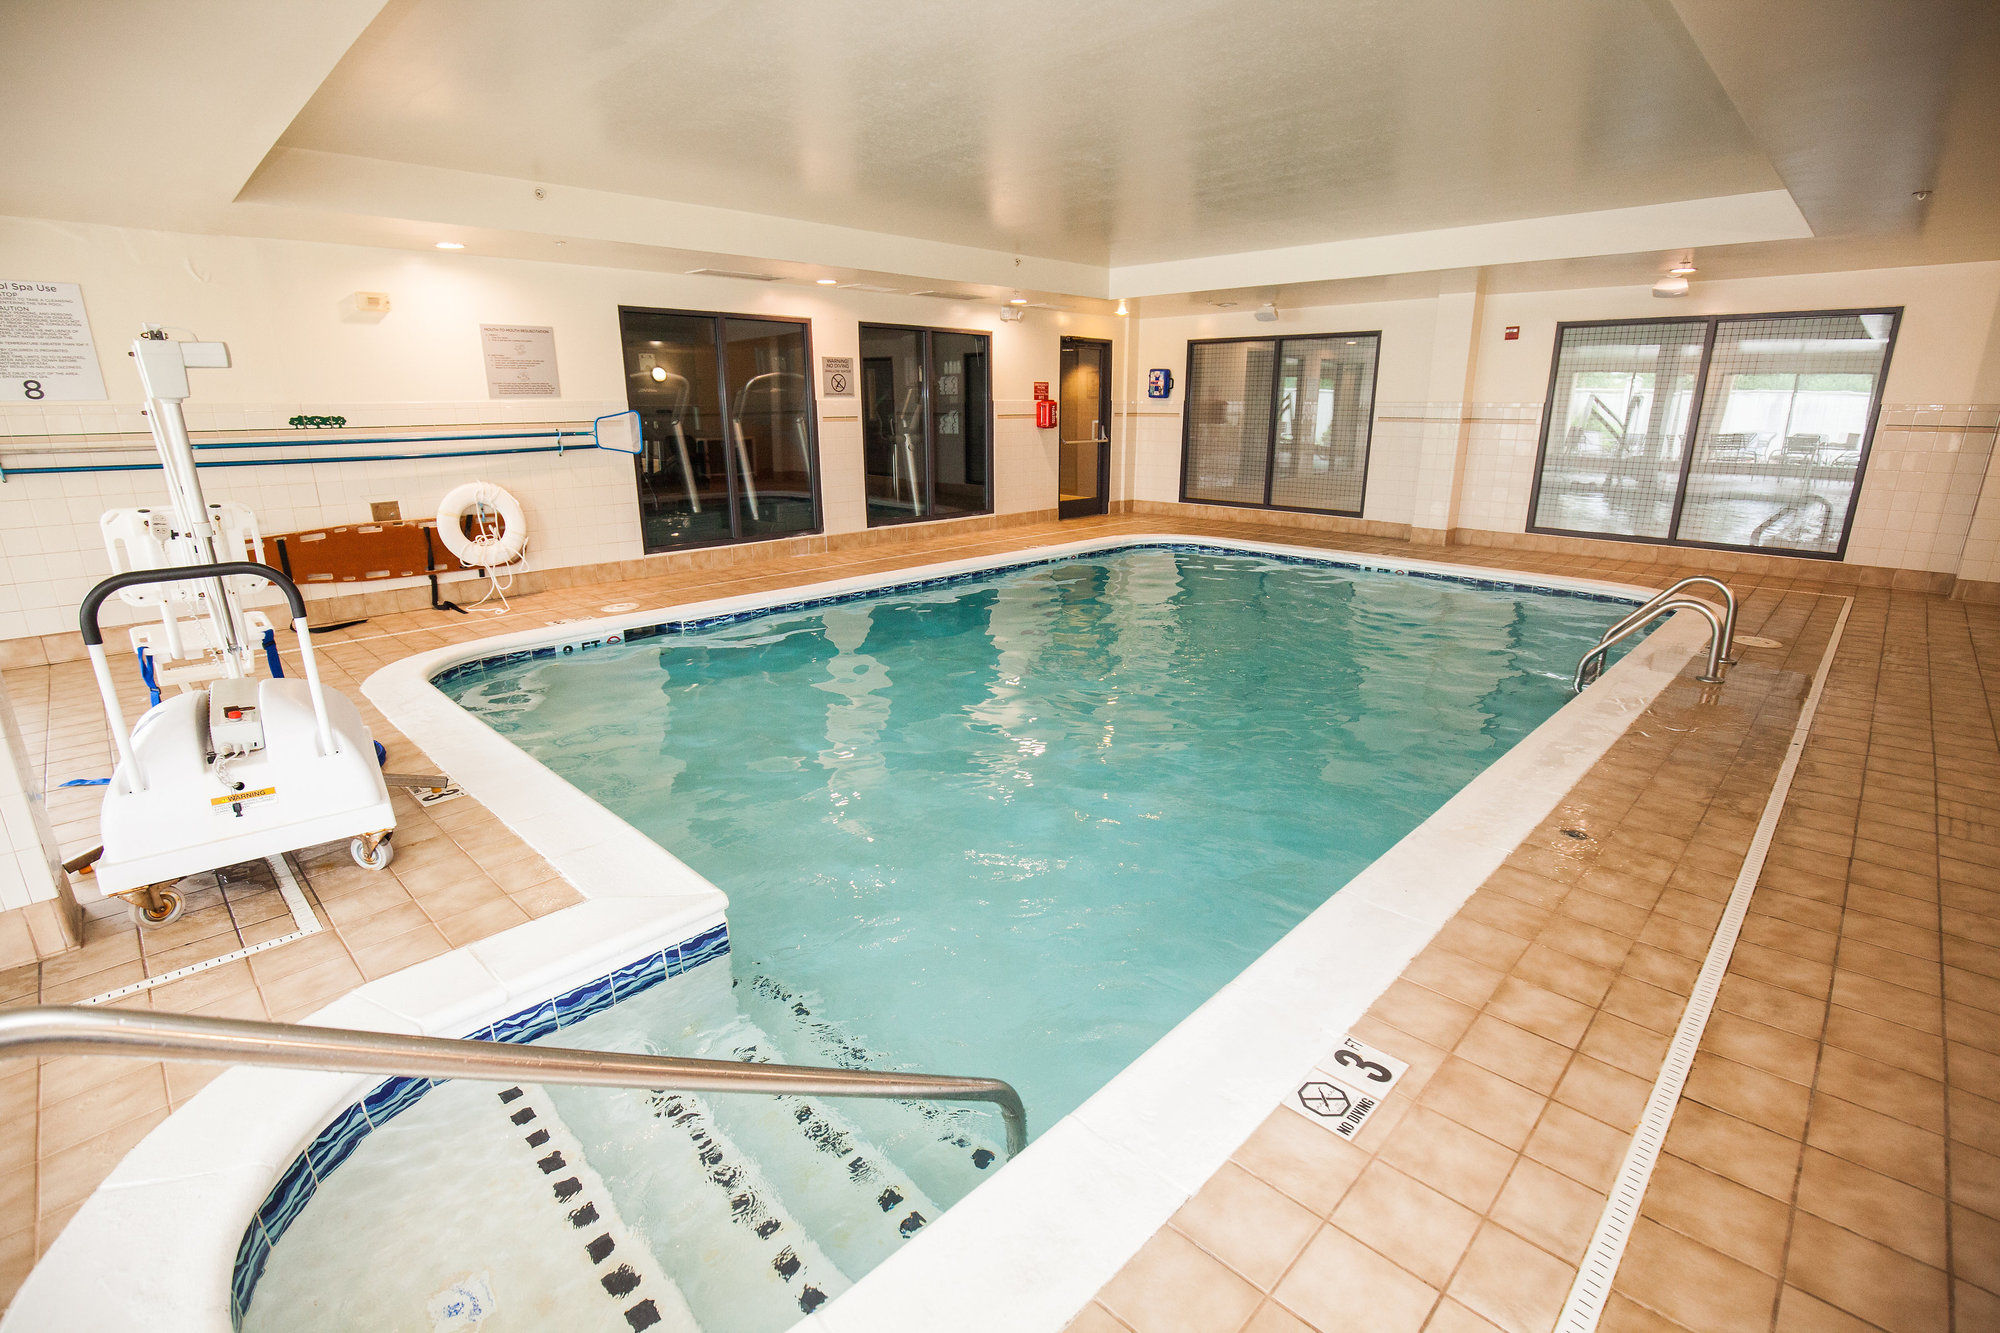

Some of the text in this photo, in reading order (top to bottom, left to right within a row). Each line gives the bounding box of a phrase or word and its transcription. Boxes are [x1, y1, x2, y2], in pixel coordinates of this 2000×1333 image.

[11, 283, 33, 291] Spa
[36, 284, 57, 292] Use
[23, 379, 45, 400] 8
[227, 790, 266, 802] WARNING
[1344, 1038, 1364, 1051] FT
[1334, 1049, 1392, 1083] 3
[1336, 1097, 1375, 1136] NO DIVING
